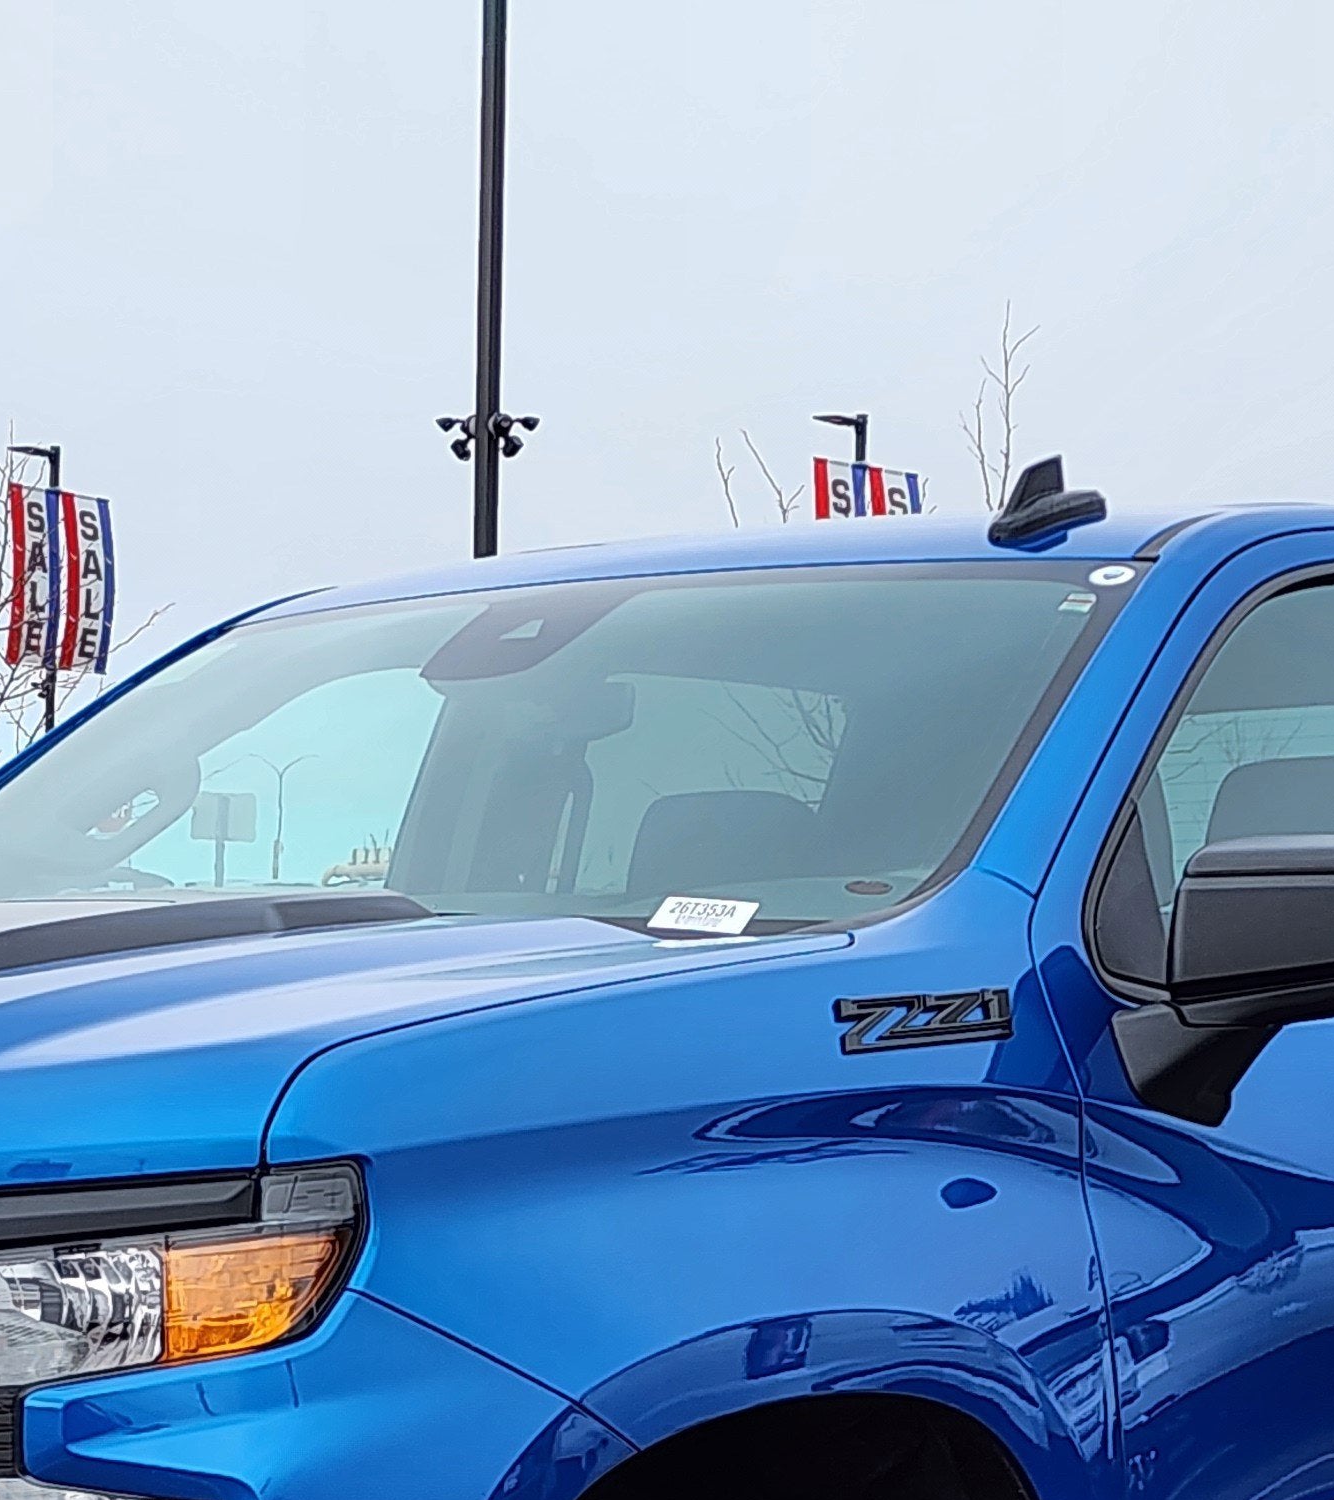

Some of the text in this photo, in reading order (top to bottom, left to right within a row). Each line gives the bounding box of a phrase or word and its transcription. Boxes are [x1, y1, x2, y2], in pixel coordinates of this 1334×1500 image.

[25, 502, 47, 654] SALE
[78, 510, 103, 658] SALE
[831, 988, 1014, 1056] Z71
